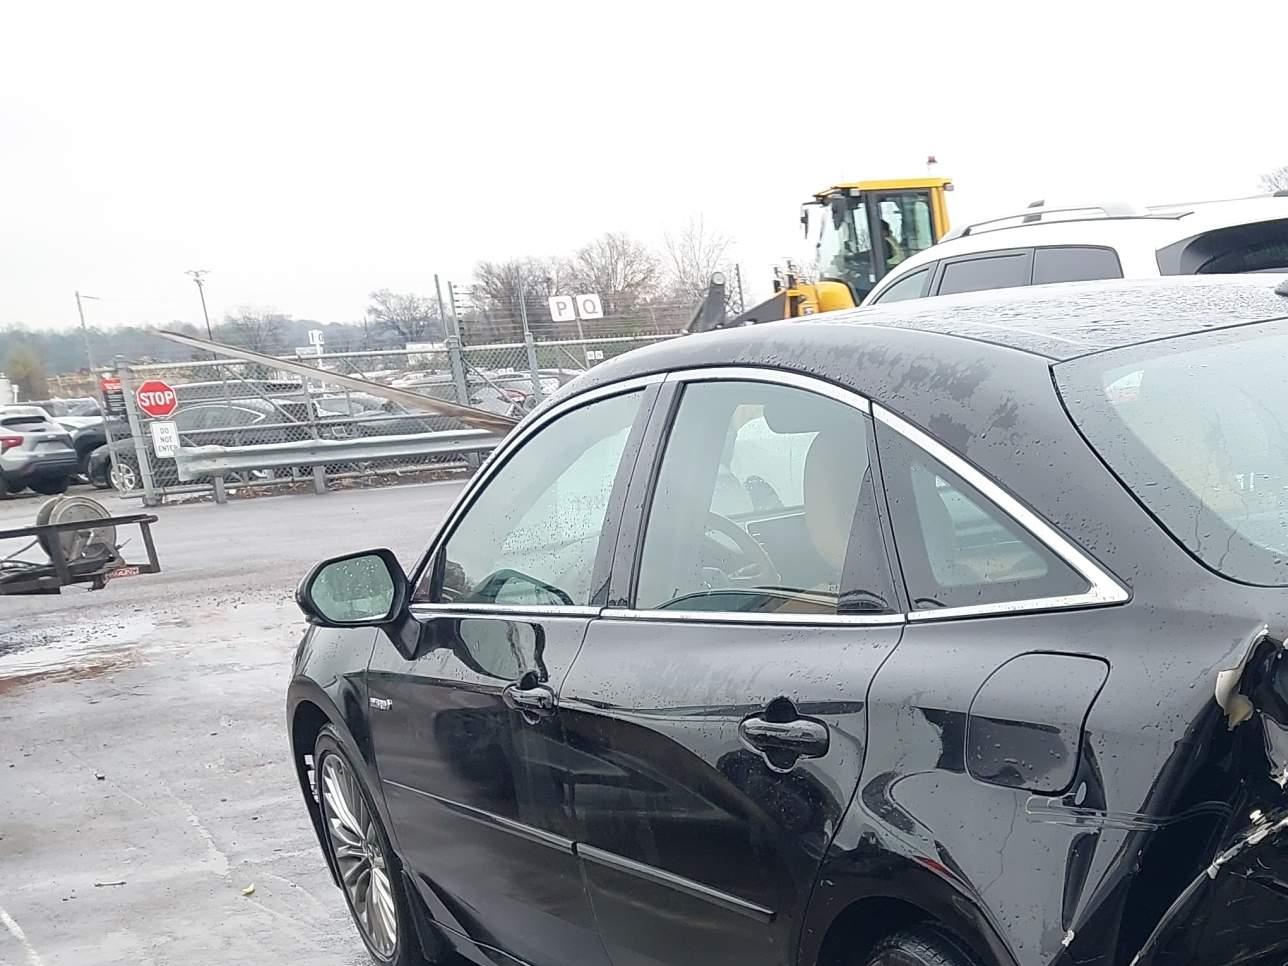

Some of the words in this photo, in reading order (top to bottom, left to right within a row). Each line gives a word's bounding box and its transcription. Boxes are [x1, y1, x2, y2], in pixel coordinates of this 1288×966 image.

[555, 301, 567, 317] P
[582, 299, 599, 315] Q
[139, 390, 174, 407] STOP
[159, 427, 170, 435] DO
[159, 436, 173, 444] NOT
[158, 444, 178, 453] ENTER
